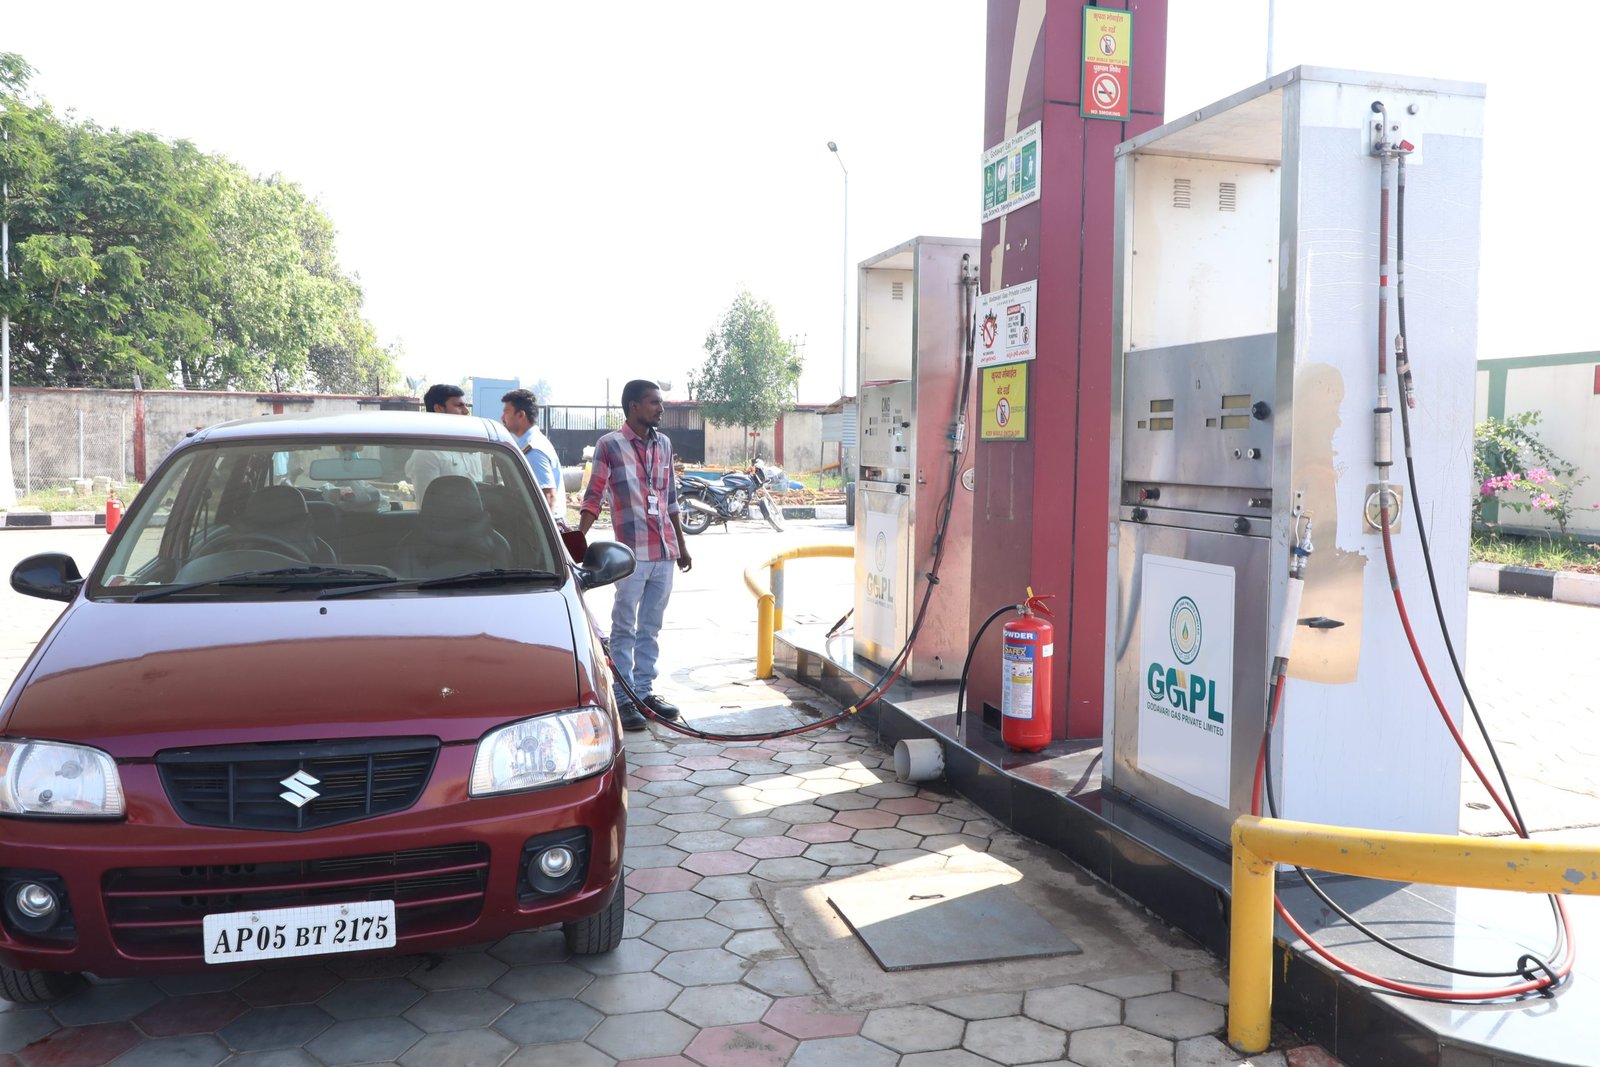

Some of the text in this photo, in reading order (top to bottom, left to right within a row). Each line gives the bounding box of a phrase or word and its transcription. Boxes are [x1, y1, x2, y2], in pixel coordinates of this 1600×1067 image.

[1147, 702, 1224, 736] GODAVARI GAS PRIVATE LIMITED
[212, 915, 388, 954] AP05 BT 2175
